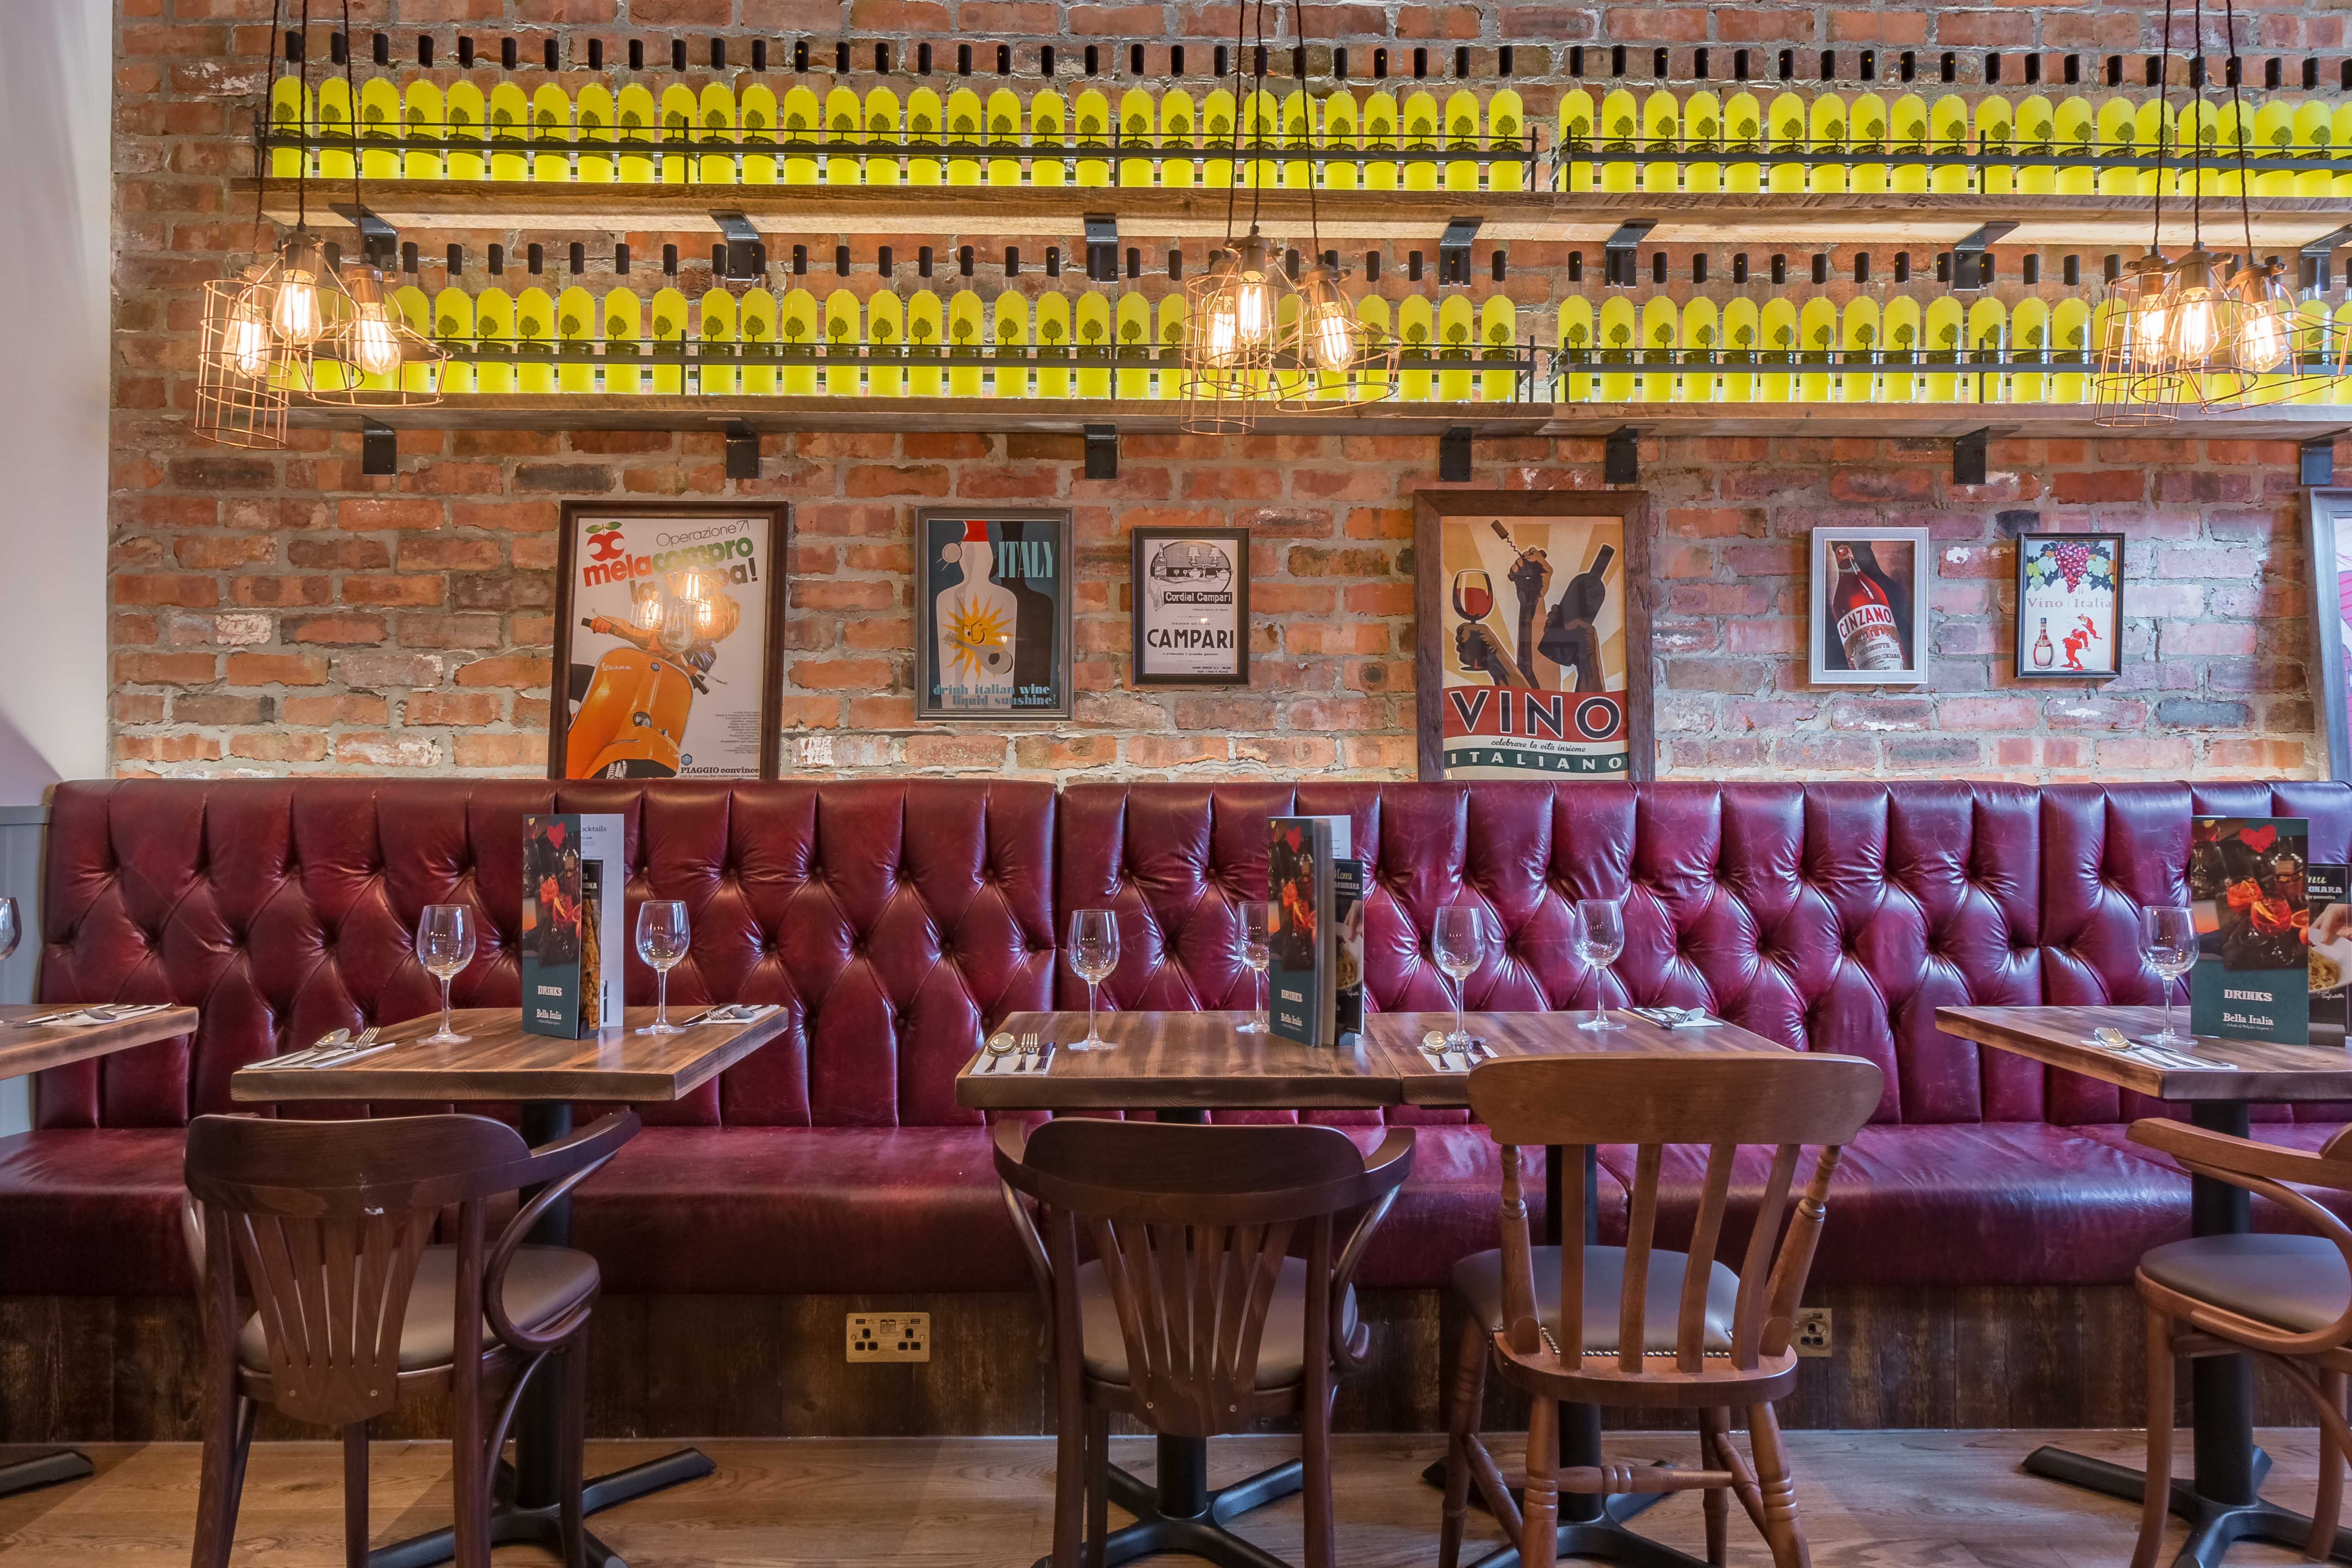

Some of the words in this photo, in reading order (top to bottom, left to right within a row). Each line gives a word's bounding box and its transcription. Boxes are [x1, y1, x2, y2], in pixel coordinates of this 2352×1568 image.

[998, 541, 1057, 578] ITALY
[1166, 592, 1194, 602] Cordial
[1197, 592, 1231, 604] Campari
[2027, 598, 2063, 608] Vino
[2075, 598, 2112, 608] Italia
[1840, 607, 1892, 639] CINZANO
[1147, 628, 1234, 649] CAMPARI
[975, 684, 1015, 695] italian
[1019, 684, 1050, 694] wine
[952, 694, 988, 708] liquid
[1449, 689, 1622, 740] VINO
[1491, 738, 1527, 748] celebrare
[1530, 740, 1537, 749] la
[1557, 744, 1586, 753] insieme
[1451, 752, 1622, 770] ITALIANO
[537, 985, 563, 997] DRINKS
[1281, 989, 1303, 1003] DRINKS
[2223, 989, 2273, 1003] DRINKS
[536, 1009, 548, 1019] Bella
[549, 1010, 562, 1020] Italia
[1281, 1012, 1291, 1023] Bella
[2222, 1012, 2247, 1023] Bella
[2248, 1014, 2274, 1026] Italia
